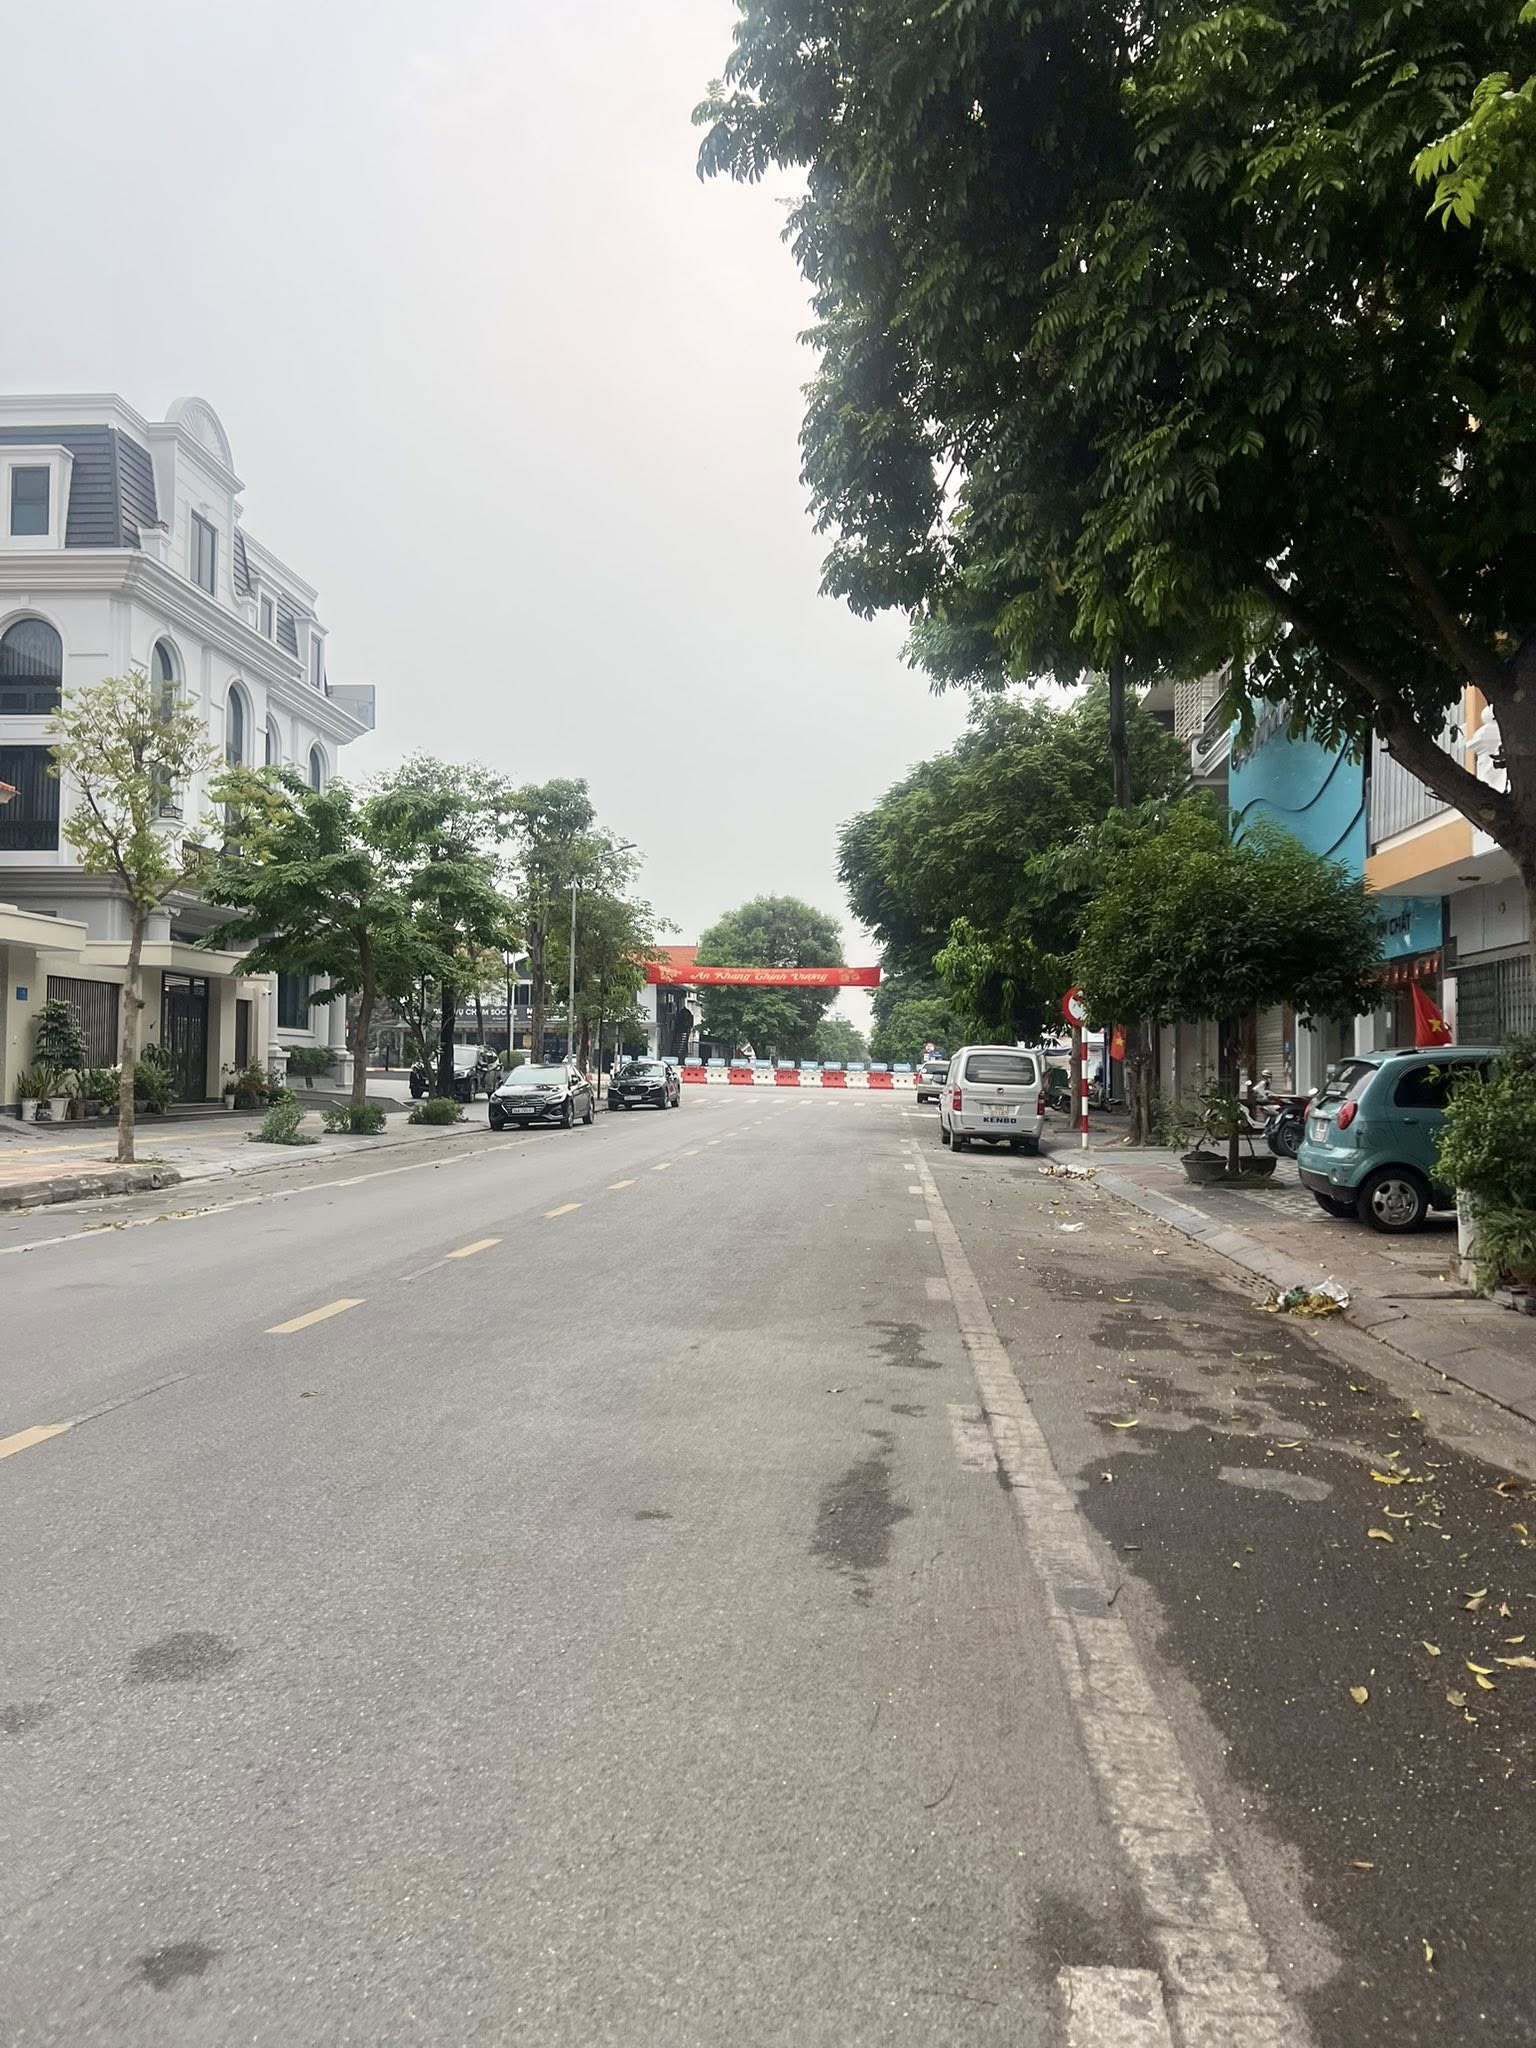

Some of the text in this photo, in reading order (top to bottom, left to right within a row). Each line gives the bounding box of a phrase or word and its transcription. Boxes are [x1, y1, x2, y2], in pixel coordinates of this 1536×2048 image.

[690, 971, 710, 980] An
[715, 972, 752, 982] Khang
[465, 1008, 489, 1016] CHM
